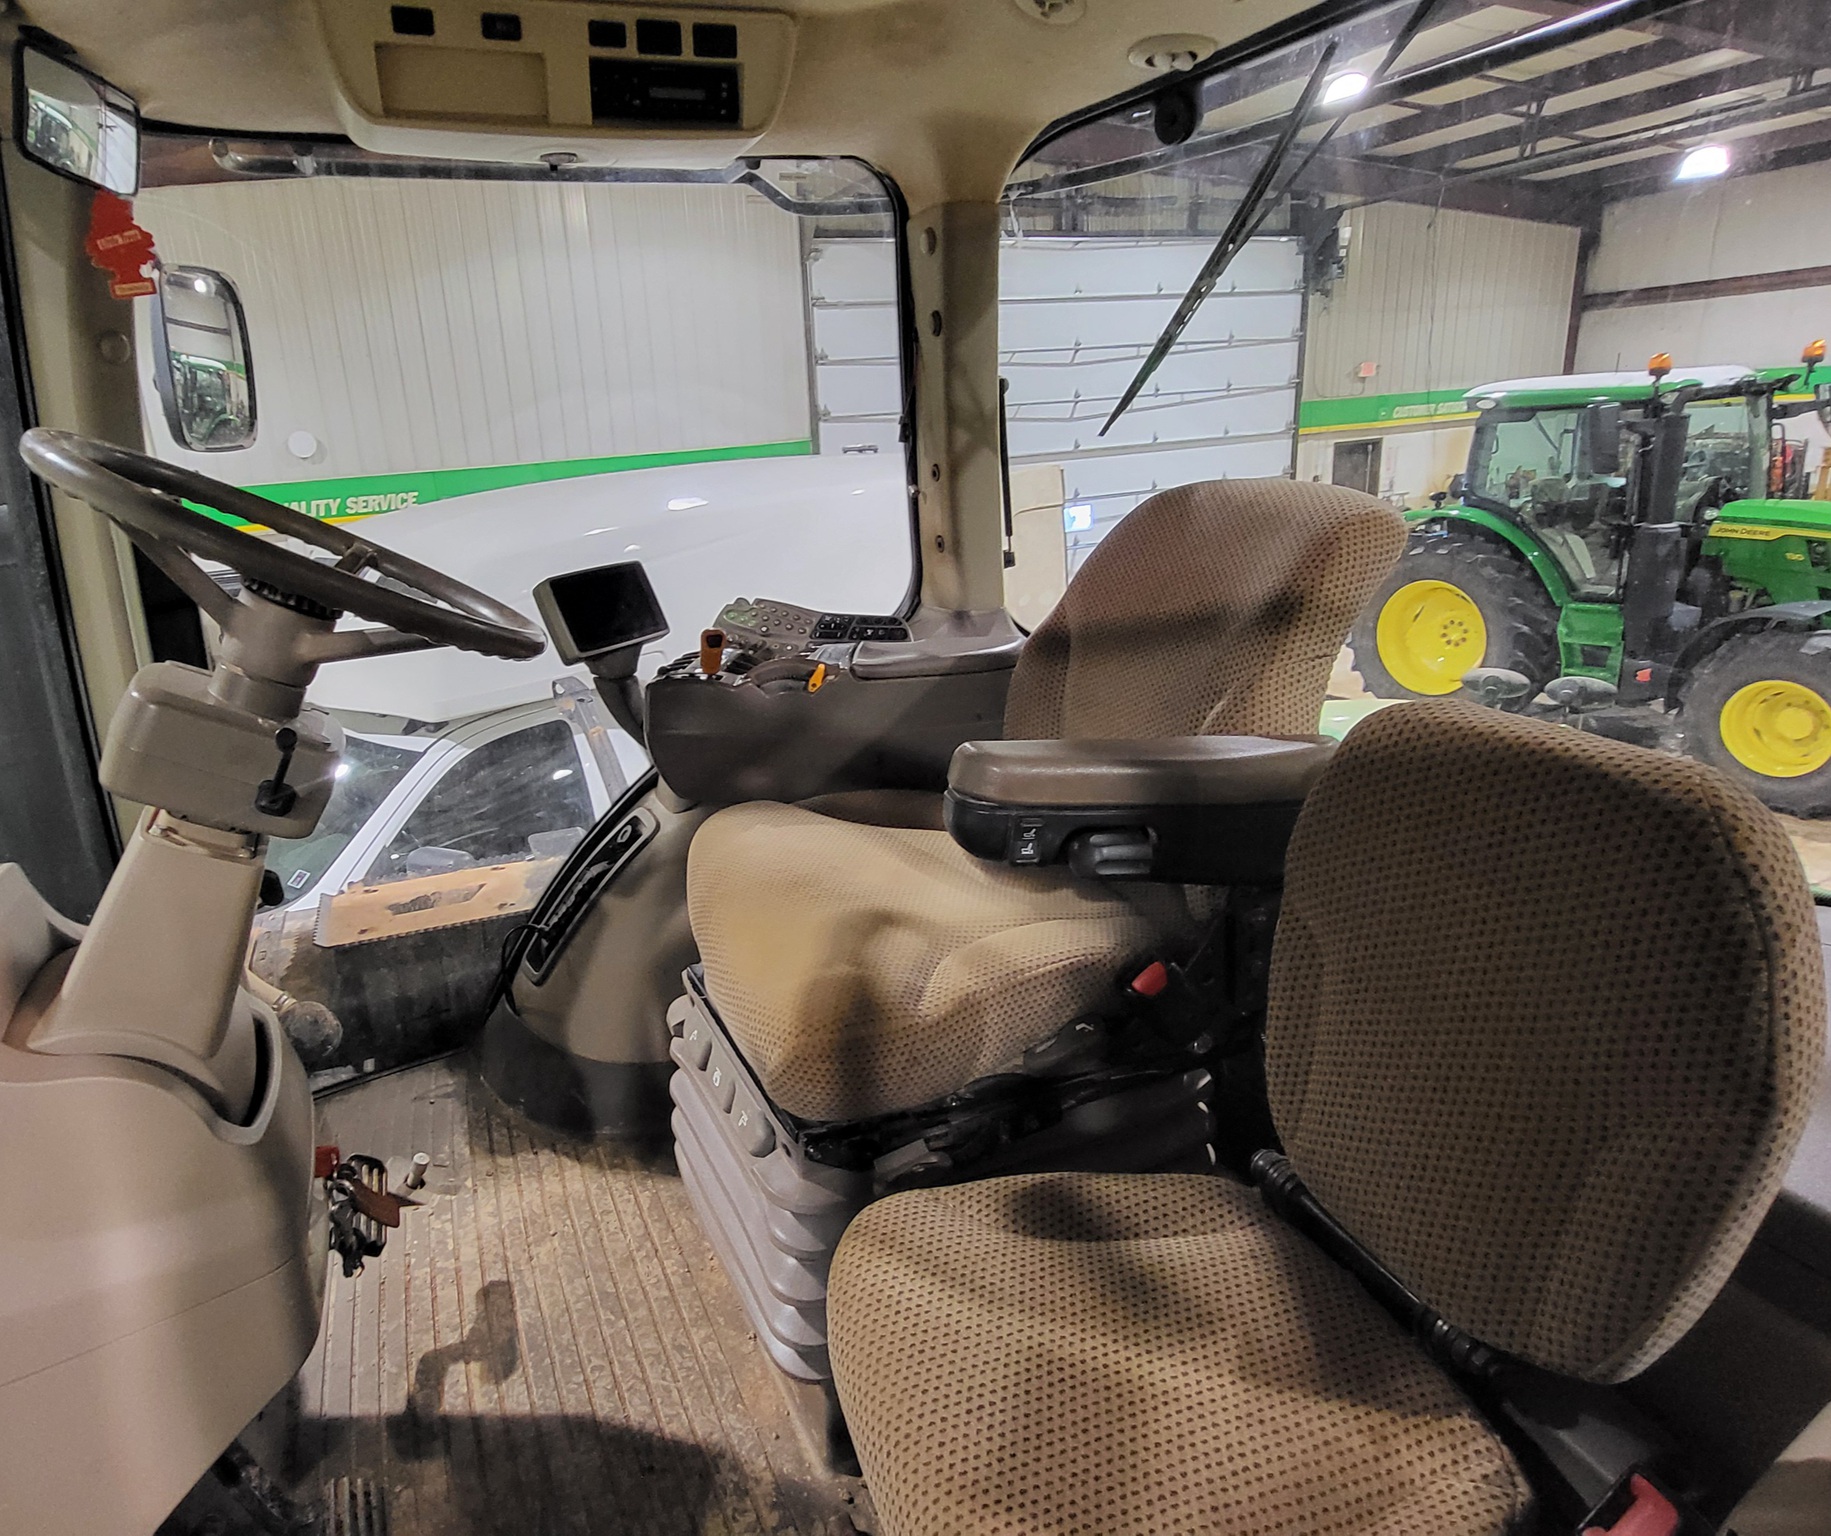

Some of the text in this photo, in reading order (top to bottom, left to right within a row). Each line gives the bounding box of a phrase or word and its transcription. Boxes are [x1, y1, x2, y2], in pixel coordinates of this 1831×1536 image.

[282, 492, 419, 517] ALITY SERVICE
[1741, 528, 1771, 537] DEERE
